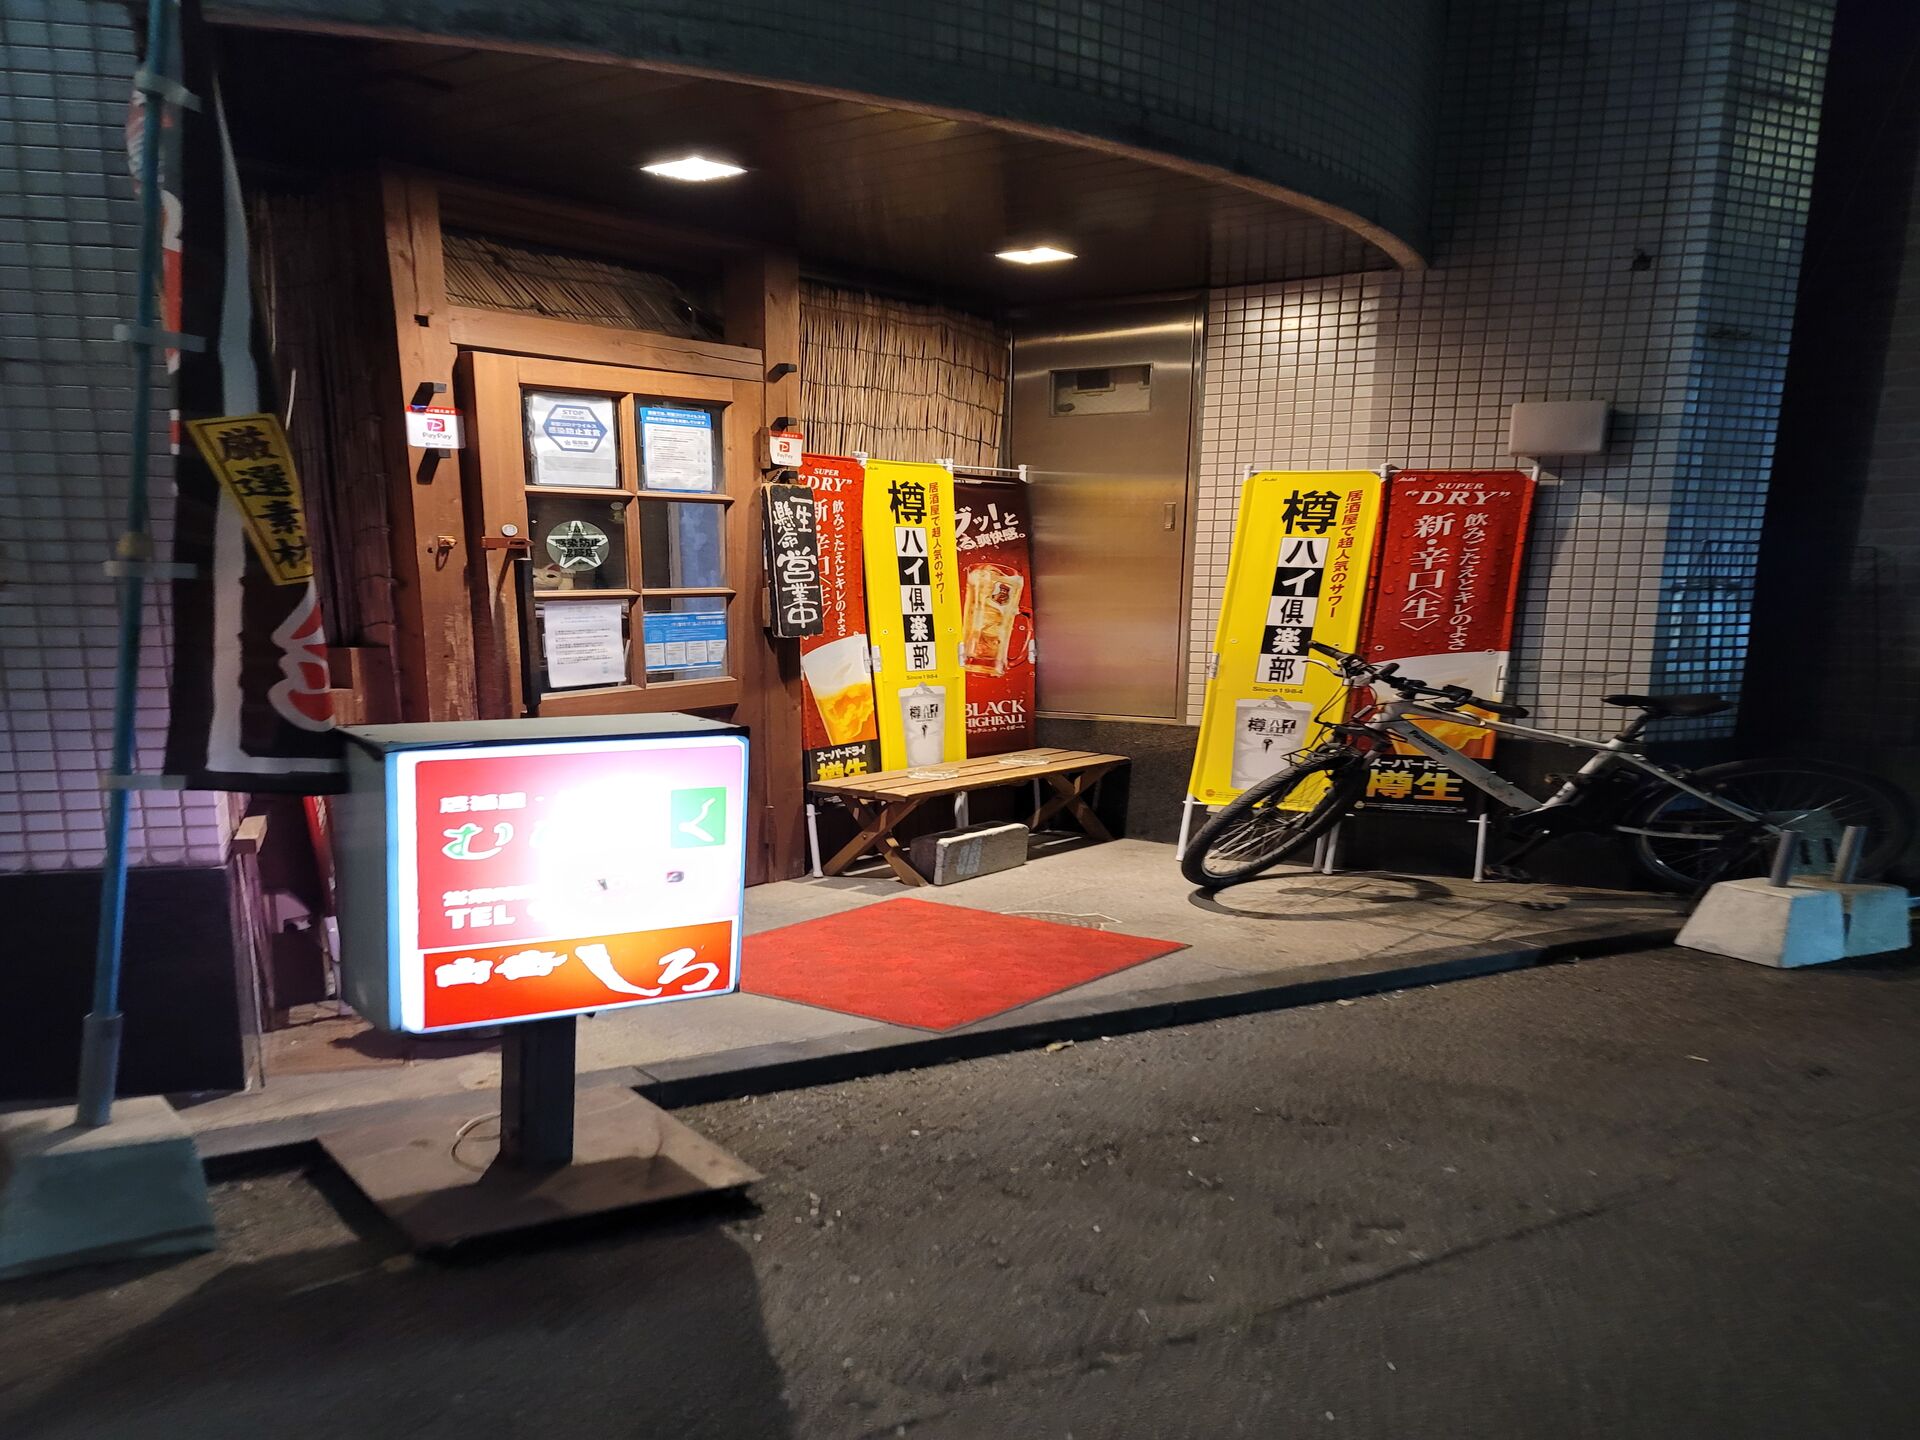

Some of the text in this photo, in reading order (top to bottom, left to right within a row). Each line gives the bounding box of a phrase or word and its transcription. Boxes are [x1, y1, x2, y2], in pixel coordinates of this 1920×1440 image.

[422, 432, 452, 440] PayPay
[813, 468, 839, 477] SUPER
[1436, 482, 1484, 490] SUPER
[929, 482, 945, 604] 居酒屋で超人気のサワー
[1328, 490, 1363, 618] 居酒屋で超人気のサワー
[832, 499, 847, 637] 飲みごたえとキレのよさ
[1448, 512, 1490, 651] 飲みごたえとキレのよさ
[817, 744, 867, 762] スーパードライ
[445, 905, 516, 929] TEL
